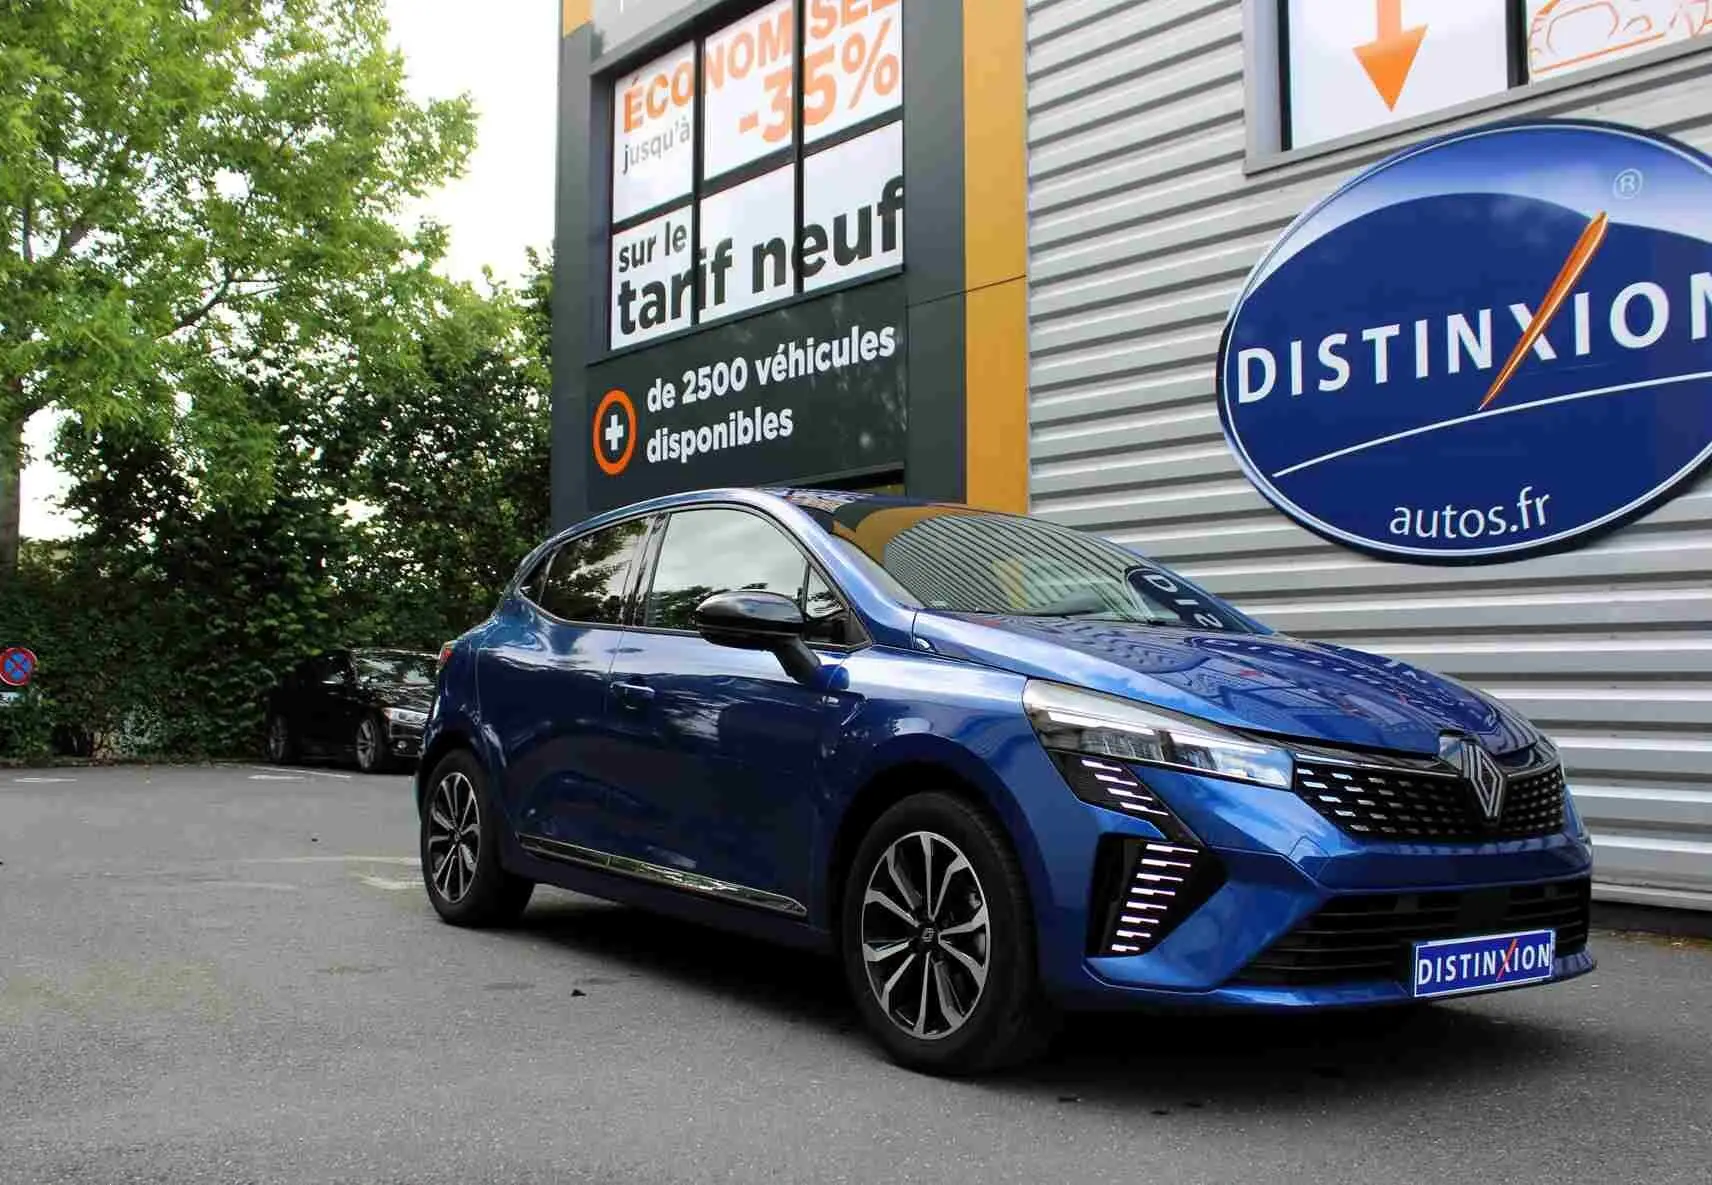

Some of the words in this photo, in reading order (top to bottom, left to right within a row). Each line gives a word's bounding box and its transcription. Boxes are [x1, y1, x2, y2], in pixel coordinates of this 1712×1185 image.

[738, 18, 900, 143] -35%
[622, 115, 691, 174] jusqu'à
[617, 237, 733, 336] tarif
[752, 175, 904, 294] neuf
[618, 235, 656, 273] sur
[664, 221, 688, 256] le
[647, 378, 676, 413] de
[681, 356, 749, 405] 2500
[754, 325, 896, 386] véhicules
[646, 405, 794, 464] disponibles
[1389, 485, 1551, 540] autos.fr
[1416, 942, 1551, 985] DISTINXION
